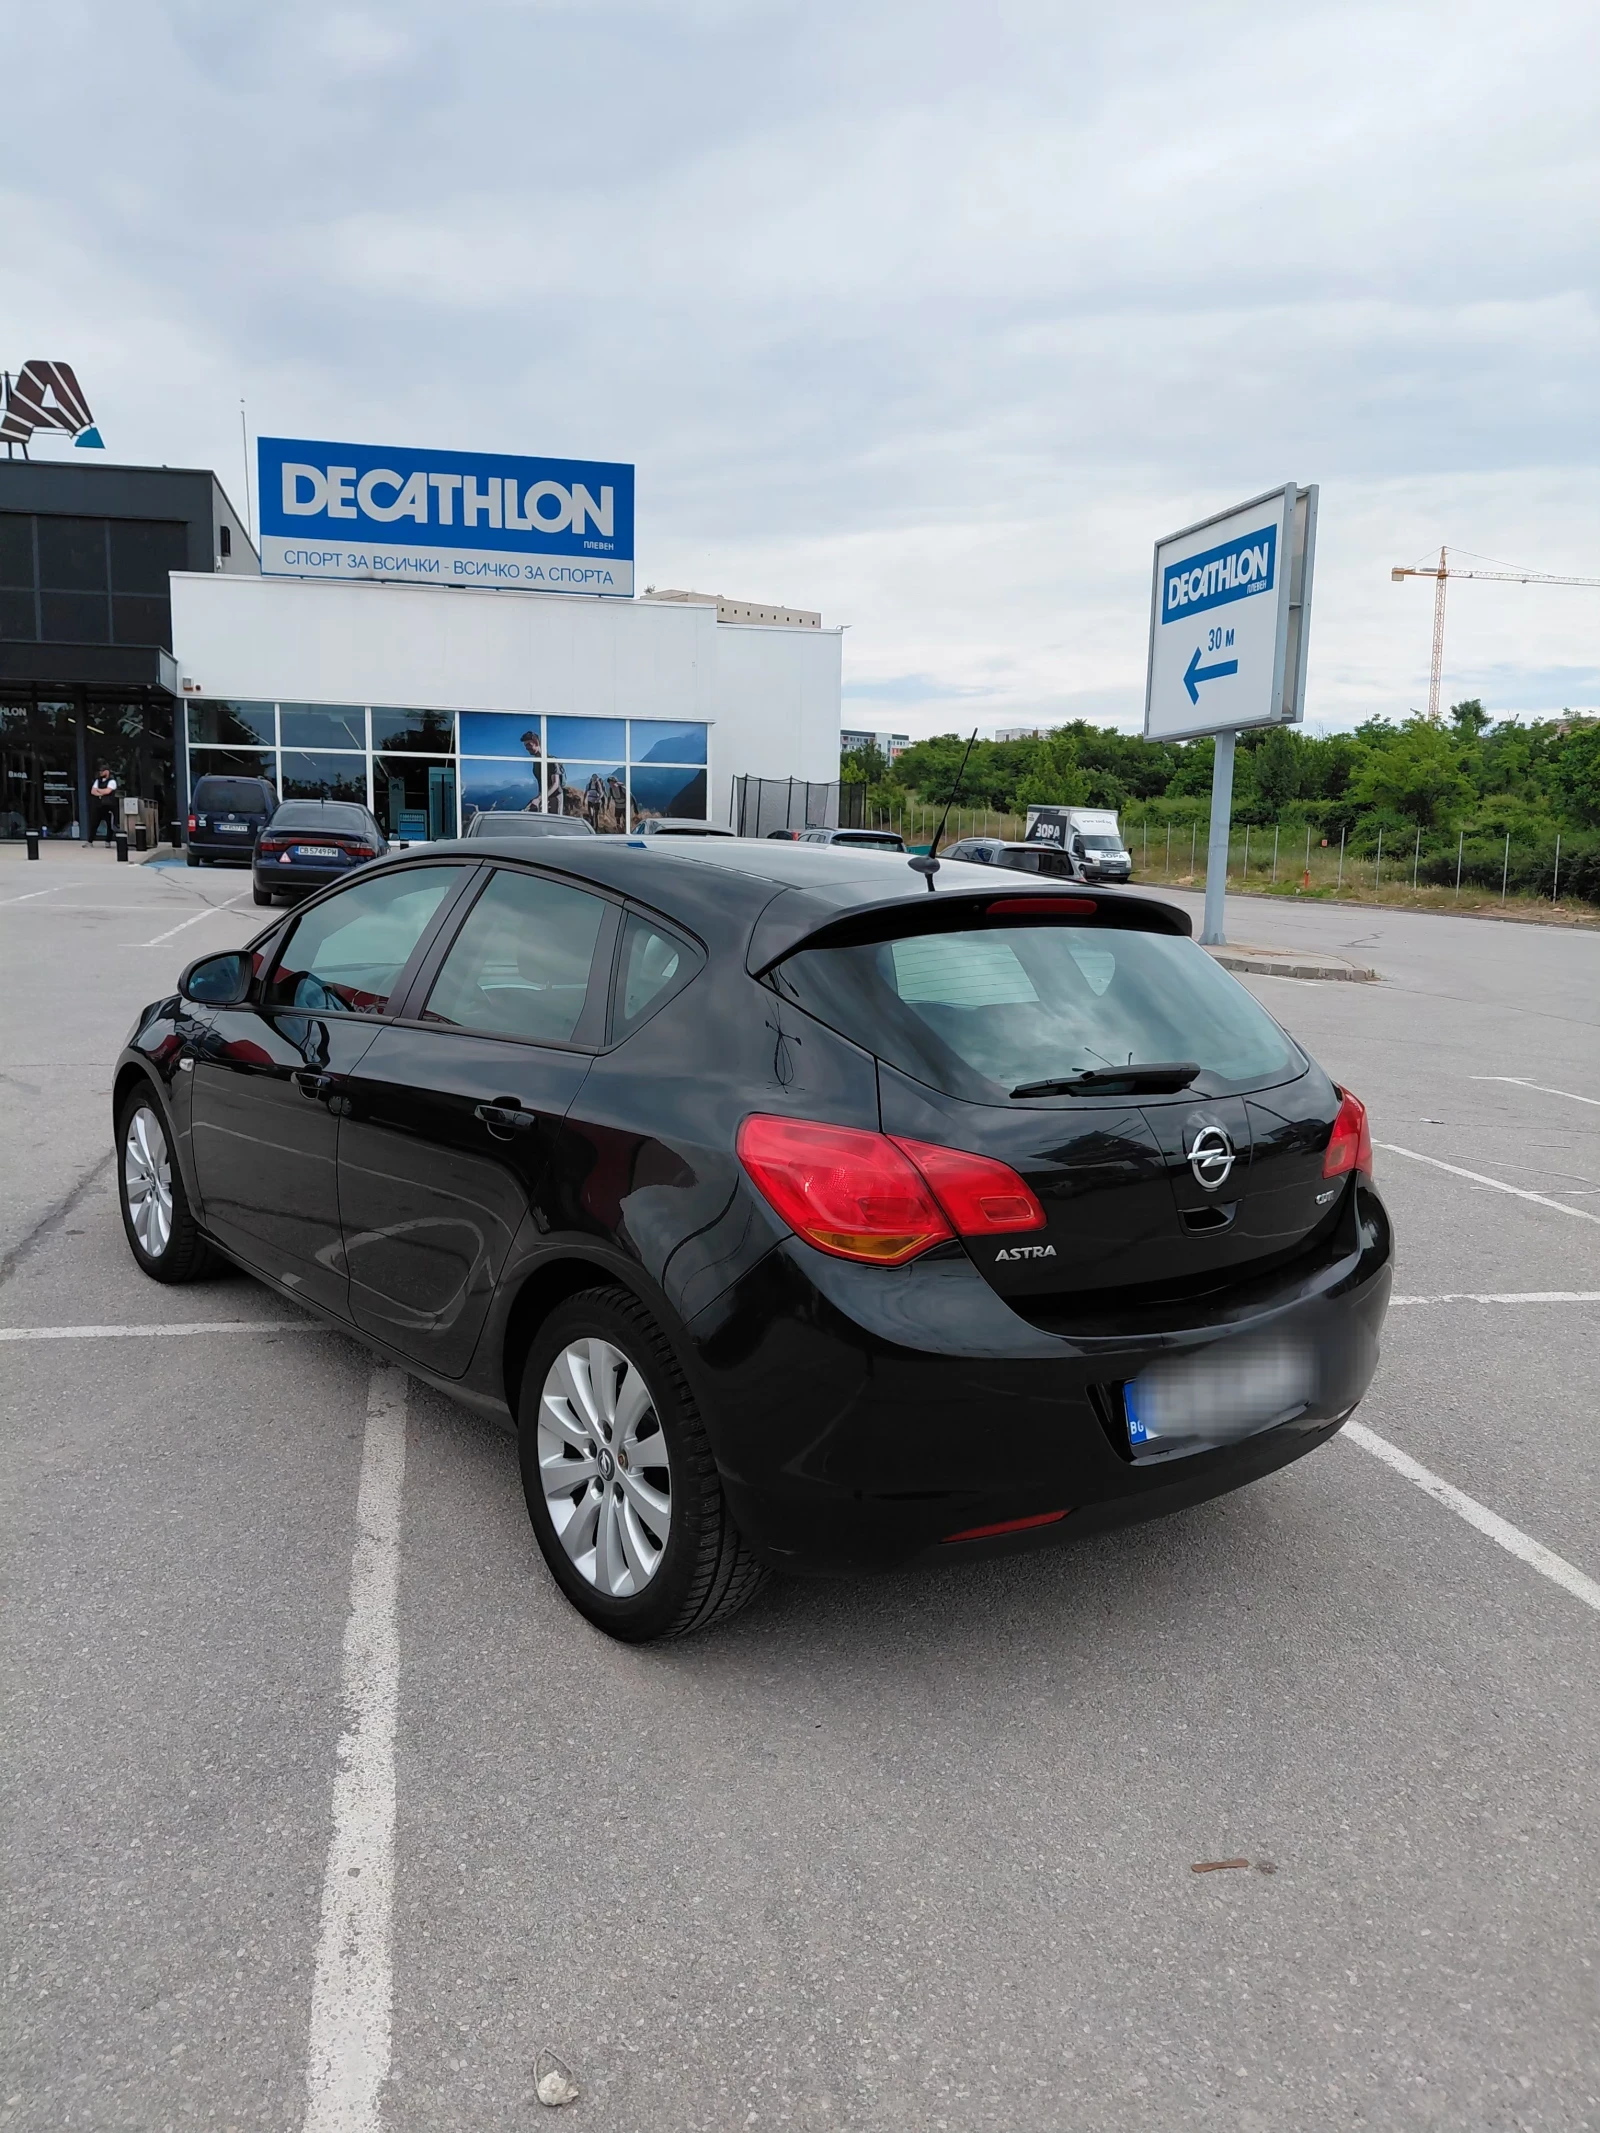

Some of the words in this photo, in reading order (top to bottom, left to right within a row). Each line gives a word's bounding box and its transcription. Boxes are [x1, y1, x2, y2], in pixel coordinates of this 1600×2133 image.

[0, 360, 105, 449] A
[281, 462, 614, 537] DECATHLON
[583, 540, 614, 550] ПЛЕВЕН
[284, 550, 343, 568] СПОРТ
[347, 552, 368, 569] ЗА
[373, 553, 440, 573] ВСИЧКИ
[454, 561, 520, 579] ВСИЧКО
[524, 564, 545, 580] ЗА
[548, 565, 614, 585] СПОРТА
[1167, 542, 1269, 610] DECATHLON
[1246, 579, 1267, 595] ПЛЕВЕН
[1208, 626, 1222, 651] 30
[1035, 823, 1060, 840] ЗОРА
[309, 847, 327, 855] 5749
[995, 1244, 1057, 1261] ASTRA
[1130, 1420, 1144, 1435] BG
